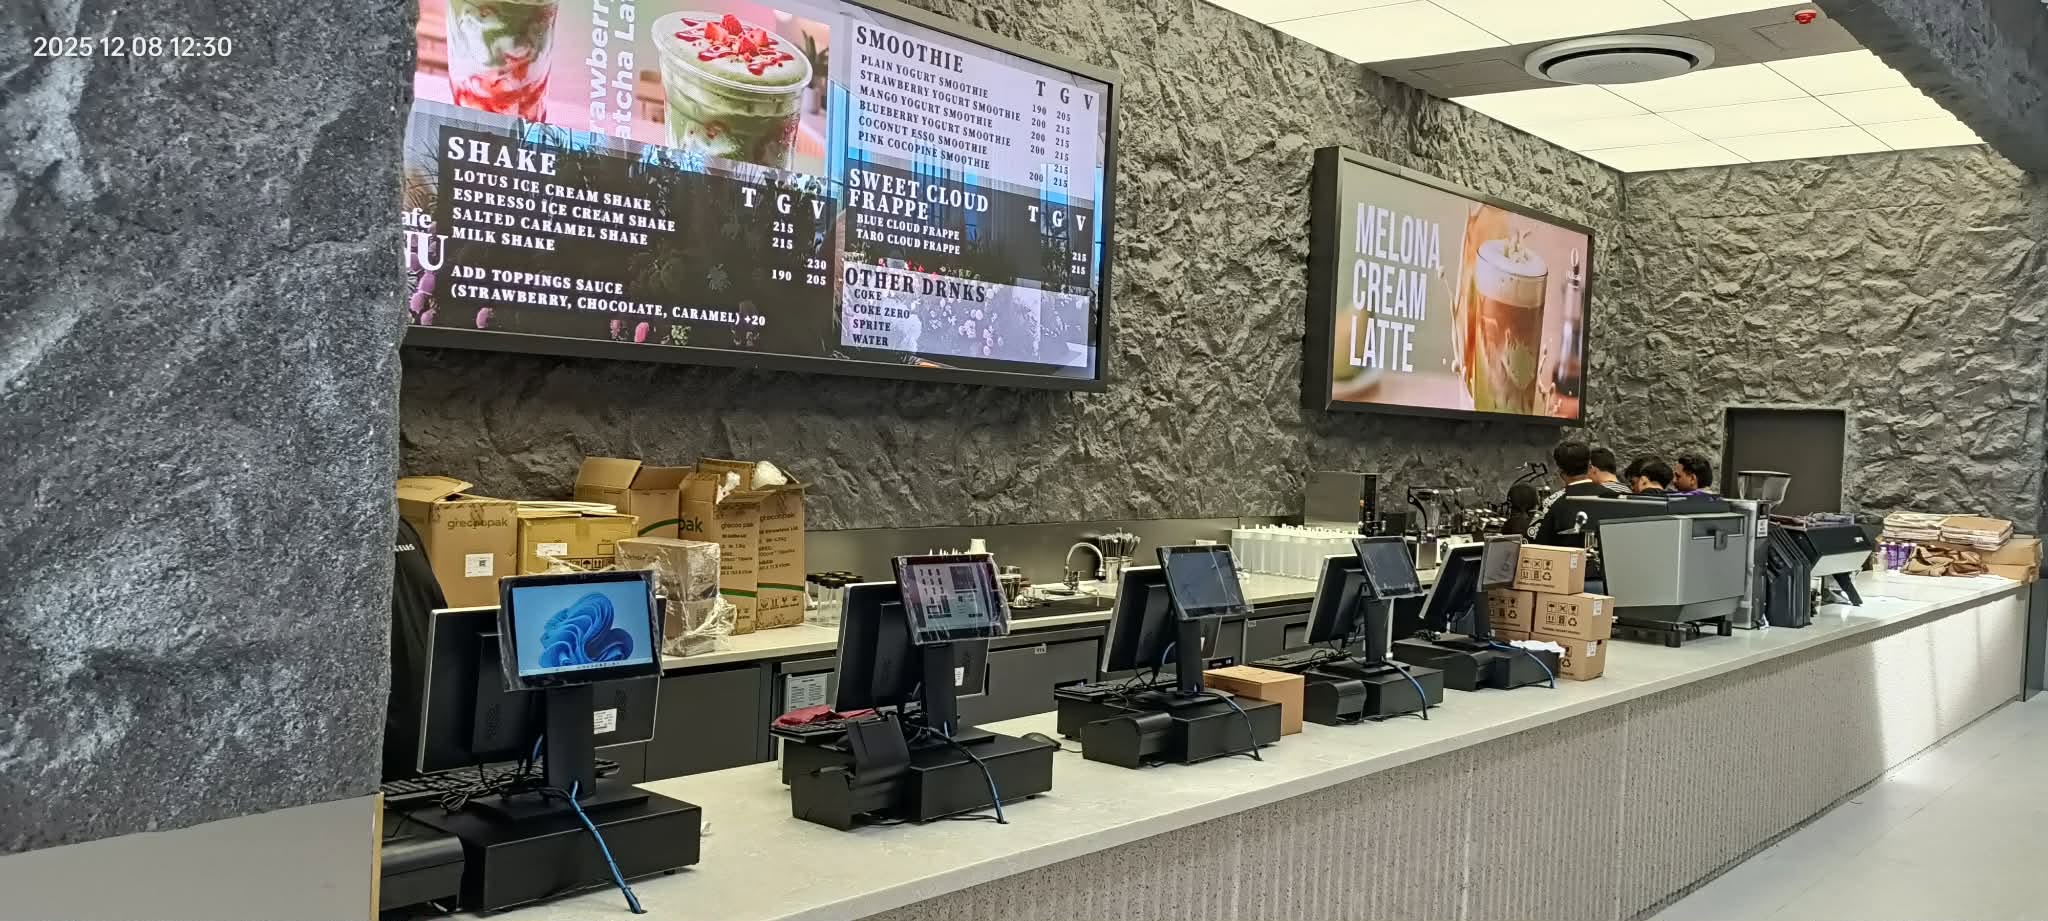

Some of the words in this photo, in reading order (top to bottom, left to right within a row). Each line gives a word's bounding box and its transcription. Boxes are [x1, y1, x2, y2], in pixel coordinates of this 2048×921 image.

[615, 0, 635, 41] La
[857, 26, 963, 74] SMOOTHIE
[861, 54, 893, 73] PLAIN
[896, 65, 936, 84] YOGURT
[939, 77, 989, 99] SMOOTHIE
[860, 70, 930, 97] STRAWBERRY
[932, 89, 971, 107] YOGURT
[973, 100, 1021, 122] SMOOTHIE
[860, 85, 898, 104] MANGO
[901, 96, 940, 115] YOGURT
[943, 107, 993, 128] SMOOTHIE
[1036, 80, 1046, 97] T
[1060, 87, 1070, 104] G
[1084, 94, 1093, 110] V
[859, 100, 919, 124] BLUEBERRY
[922, 115, 960, 134] YOGURT
[963, 126, 1011, 147] SMOOTHIE
[1031, 118, 1046, 129] 200
[1056, 125, 1070, 136] 215
[1032, 105, 1047, 115] 190
[1057, 111, 1071, 122] 205
[858, 131, 885, 146] PINK
[887, 138, 938, 158] COCOPINE
[941, 149, 990, 170] SMOOTHIE
[859, 116, 908, 137] COCONUT
[911, 129, 935, 143] ESSO
[938, 135, 988, 155] SMOOTHIE
[1031, 132, 1046, 142] 200
[1055, 138, 1069, 149] 215
[447, 136, 556, 176] SHAKE
[1030, 145, 1045, 156] 200
[1055, 151, 1069, 162] 215
[1029, 172, 1044, 183] 200
[1053, 177, 1068, 188] 215
[1054, 164, 1069, 175] 215
[454, 168, 508, 188] LOTUS
[513, 178, 540, 194] ICE
[545, 183, 599, 203] CREAM
[603, 193, 652, 211] SHAKE
[741, 187, 757, 208] T
[777, 194, 792, 214] G
[811, 200, 825, 219] V
[849, 168, 920, 199] SWEET
[927, 184, 988, 213] CLOUD
[849, 188, 929, 220] FRAPPE
[453, 188, 536, 211] ESPRESSO
[542, 200, 567, 216] ICE
[572, 206, 624, 225] CREAM
[629, 214, 676, 232] SHAKE
[1028, 205, 1039, 223] T
[1052, 210, 1064, 227] G
[1076, 214, 1087, 232] V
[453, 207, 515, 226] SALTED
[520, 217, 596, 239] CARAMEL
[600, 229, 648, 246] SHAKE
[453, 225, 496, 243] MILK
[501, 233, 556, 251] SHAKE
[773, 221, 794, 234] 215
[856, 228, 884, 242] TARO
[887, 233, 920, 248] CLOUD
[924, 239, 960, 255] FRAPPE
[857, 213, 884, 228] BLUE
[887, 219, 920, 234] CLOUD
[923, 225, 960, 241] FRAPPE
[1355, 203, 1440, 271] MELONA
[772, 237, 793, 250] 215
[1072, 252, 1087, 263] 215
[771, 269, 792, 281] 190
[806, 274, 826, 286] 205
[807, 258, 827, 270] 230
[1071, 265, 1086, 275] 215
[451, 265, 486, 279] ADD
[492, 269, 571, 289] TOPPINGS
[576, 278, 624, 295] SAUCE
[845, 267, 915, 294] OTHER
[922, 278, 986, 303] DRNKS
[854, 289, 882, 301] COKE
[1352, 259, 1428, 321] CREAM
[451, 283, 572, 309] (STRAWBERRY,
[577, 297, 667, 318] CHOCOLATE,
[672, 307, 740, 325] CARAMEL)
[744, 315, 766, 326] +20
[853, 304, 882, 316] COKE
[884, 307, 910, 319] ZERO
[852, 334, 888, 347] WATER
[853, 319, 891, 332] SPRITE
[1349, 315, 1415, 373] LATTE
